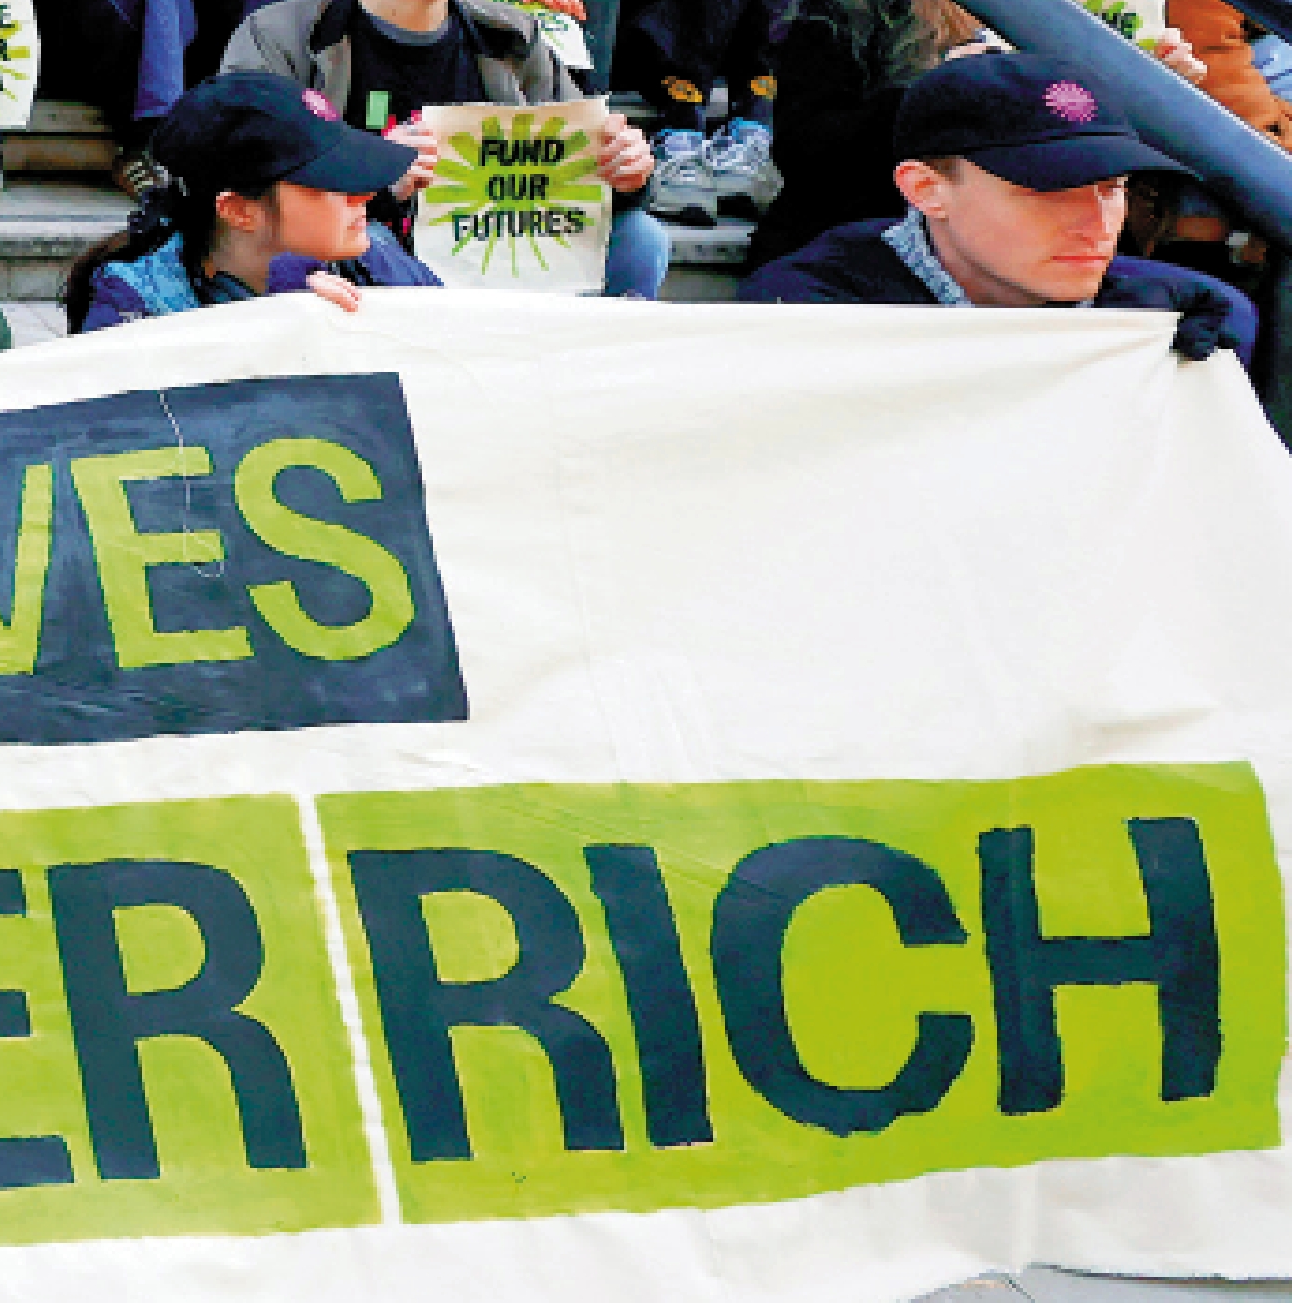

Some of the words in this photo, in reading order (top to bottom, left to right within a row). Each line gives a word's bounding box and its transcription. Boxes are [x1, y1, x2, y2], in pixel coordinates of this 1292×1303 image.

[479, 139, 566, 166] FUND
[487, 173, 550, 201] OUR
[451, 207, 587, 242] FUTURES
[347, 815, 1223, 1163] RICH
